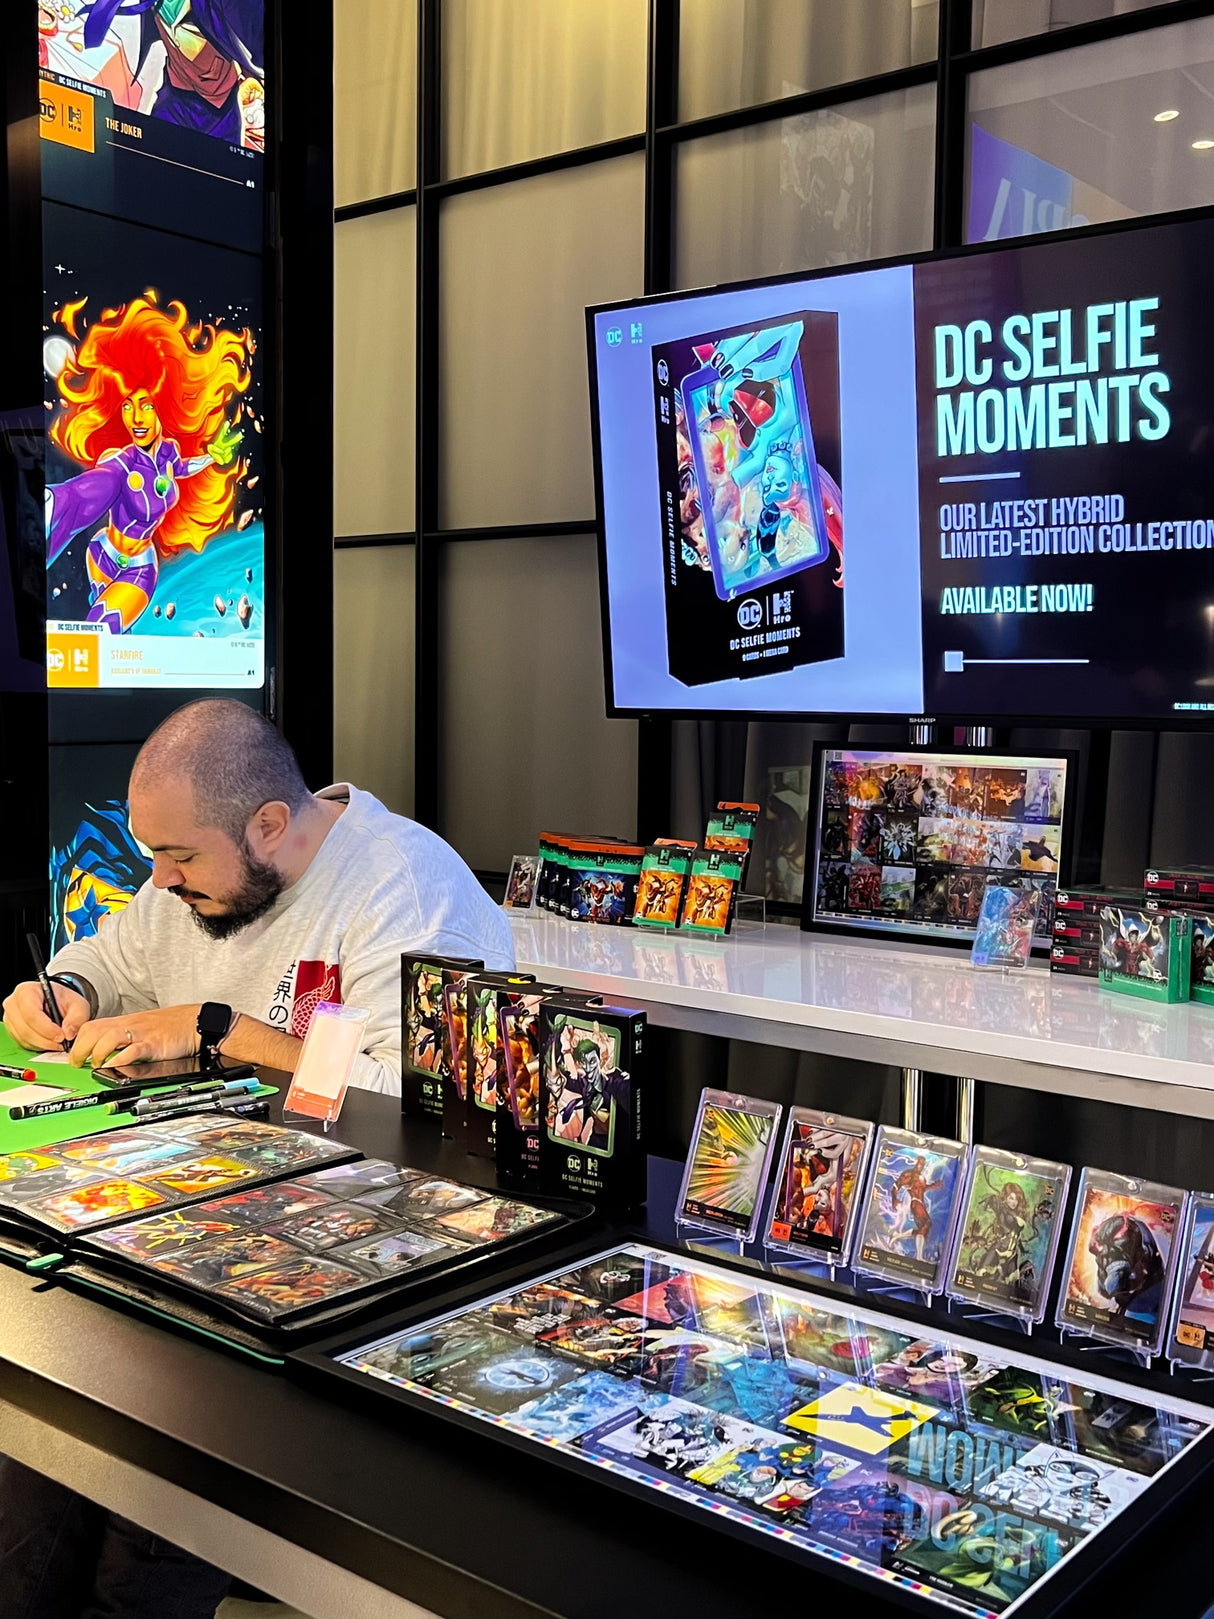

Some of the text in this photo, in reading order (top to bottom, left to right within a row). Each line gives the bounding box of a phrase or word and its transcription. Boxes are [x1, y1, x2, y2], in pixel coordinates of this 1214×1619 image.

[39, 102, 56, 118] DC
[105, 117, 143, 139] THE JOKER
[607, 330, 622, 343] DC
[935, 297, 1159, 389] DC SELFIE
[936, 371, 1171, 457] MOMENTS
[940, 494, 1125, 532] OUR LATEST HYBRID
[940, 525, 1094, 559] LIMITED-EDITION
[940, 583, 1094, 615] AVAILABLE NOW!
[739, 604, 760, 625] DC
[773, 614, 792, 625] Hro
[65, 623, 80, 631] SELFIE
[729, 626, 801, 651] DC SELFIE MOMENTS
[47, 653, 63, 667] DC
[111, 649, 144, 661] STARFIRE
[1147, 873, 1159, 883] DC
[1057, 895, 1069, 903] DC
[1146, 902, 1158, 910] DC
[1054, 922, 1066, 930] DC
[1053, 949, 1064, 958] DC
[37, 1102, 63, 1115] ARTS
[526, 1138, 540, 1150] DC
[567, 1157, 581, 1170] DC
